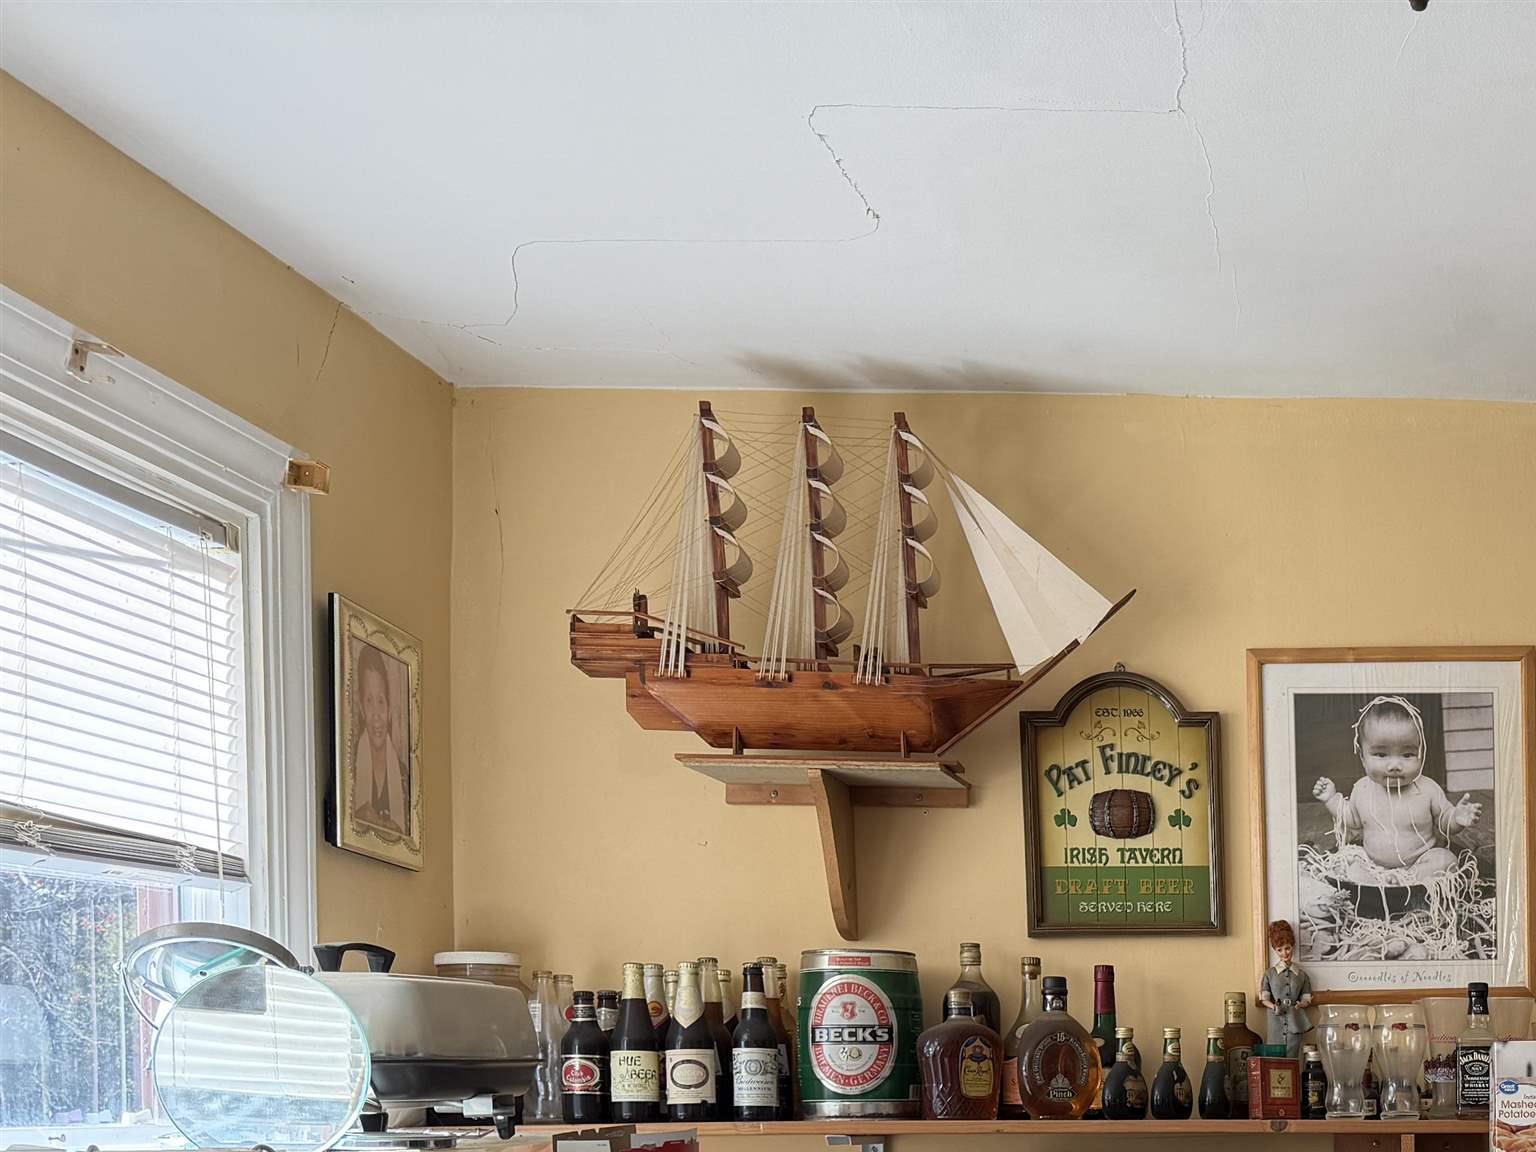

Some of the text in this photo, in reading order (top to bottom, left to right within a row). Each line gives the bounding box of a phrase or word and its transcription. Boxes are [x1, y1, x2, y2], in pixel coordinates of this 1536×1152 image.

[1123, 708, 1144, 717] 1966
[1044, 743, 1200, 799] PAT FINLEY'S
[1064, 847, 1184, 866] IRISH TAVERN
[1055, 879, 1195, 895] DRAFT BEER
[1079, 901, 1173, 913] SERVED HERE
[815, 1026, 890, 1042] BECK'S
[619, 1055, 641, 1066] HUE
[630, 1068, 658, 1081] BEER
